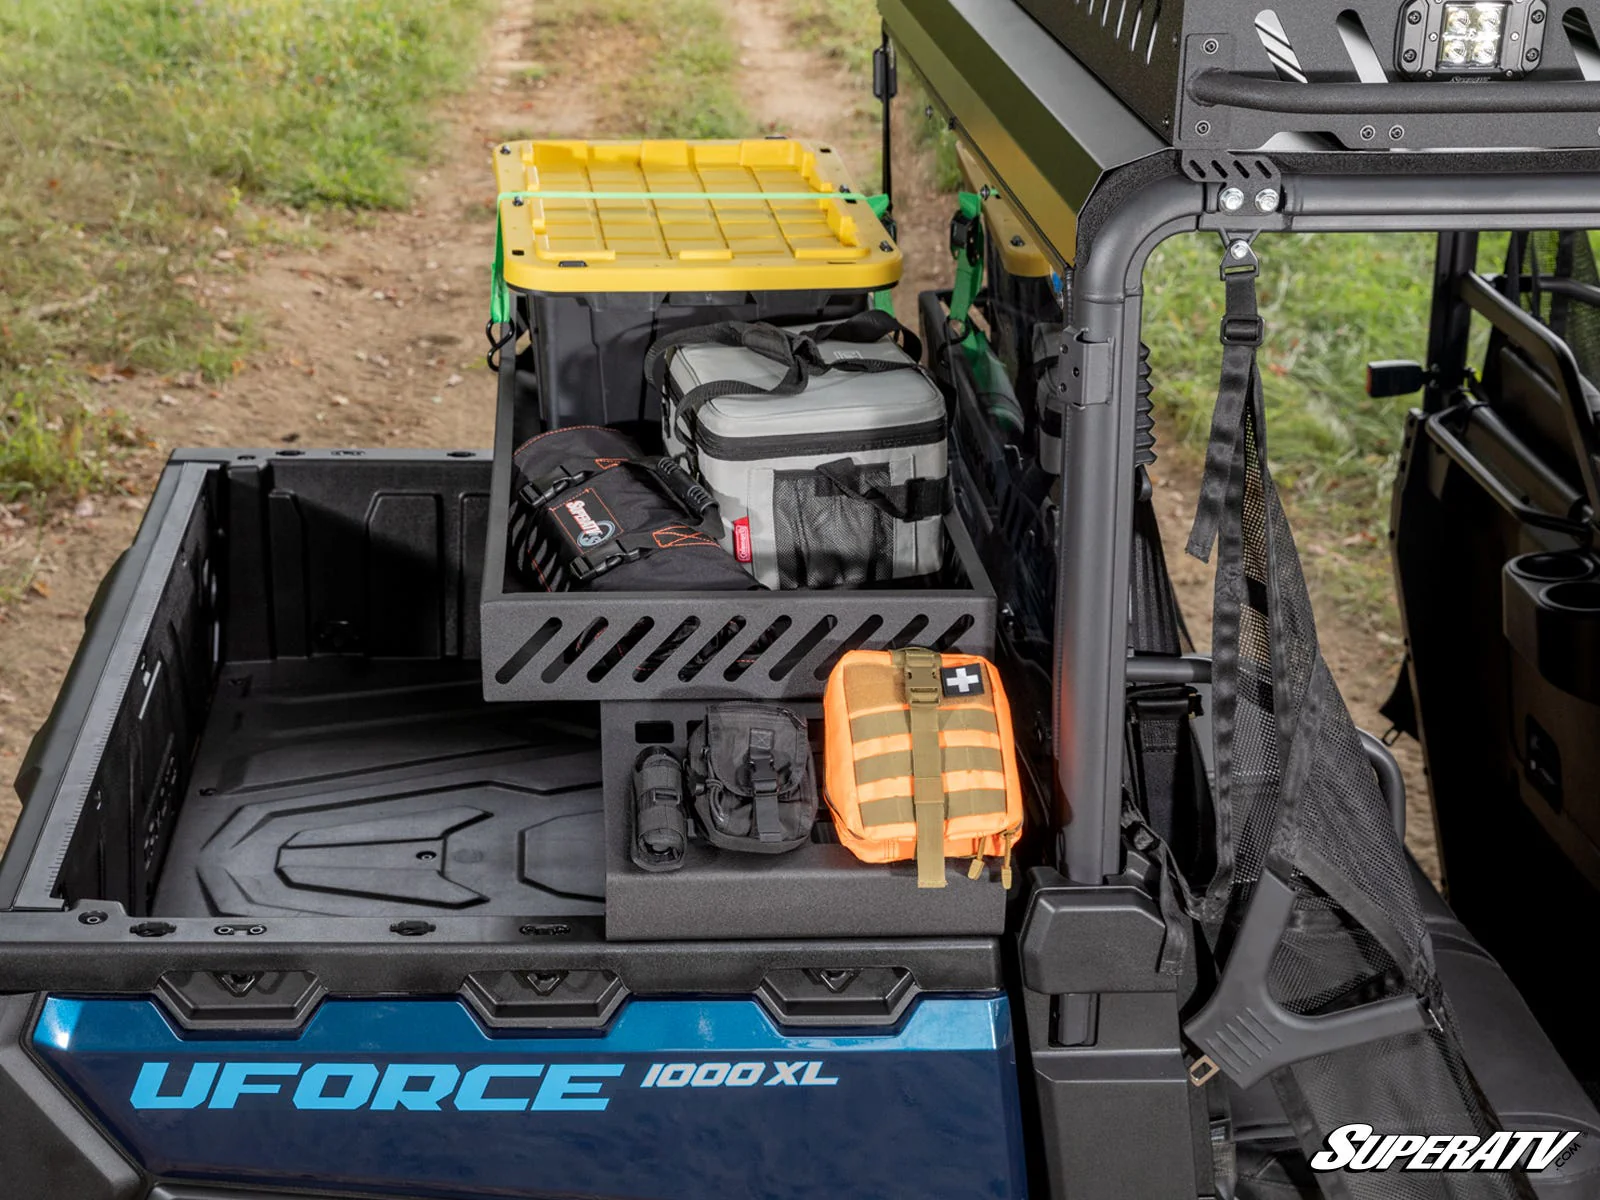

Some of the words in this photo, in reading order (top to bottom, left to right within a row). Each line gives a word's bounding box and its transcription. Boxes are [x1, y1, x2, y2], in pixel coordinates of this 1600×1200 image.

[130, 1063, 625, 1111] UFORCE
[640, 1063, 767, 1088] 1000
[763, 1061, 840, 1087] XL
